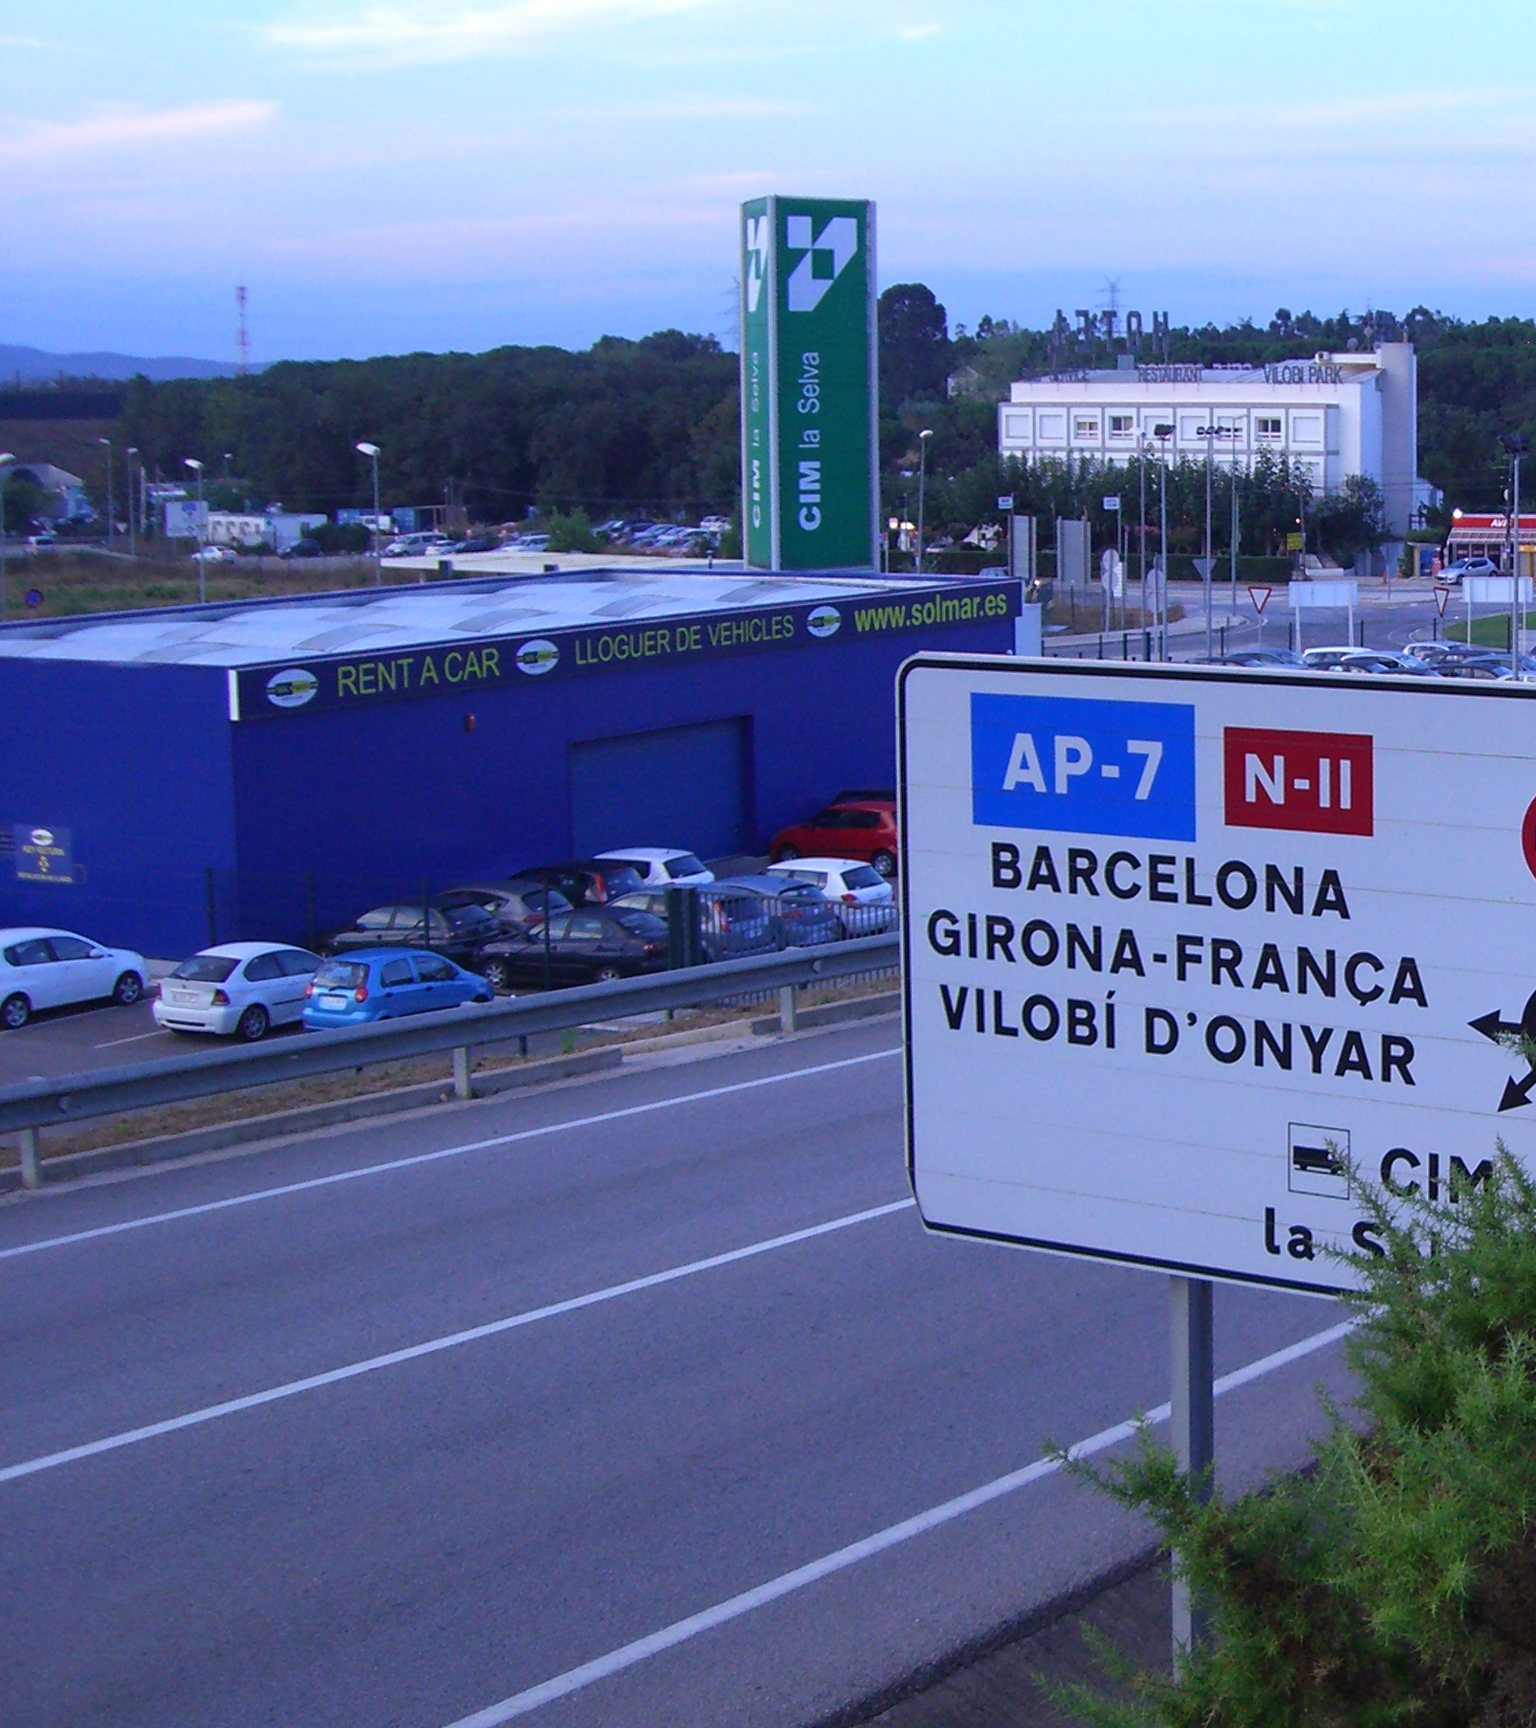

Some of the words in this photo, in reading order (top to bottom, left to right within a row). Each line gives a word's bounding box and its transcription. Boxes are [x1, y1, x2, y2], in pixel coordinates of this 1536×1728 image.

[797, 352, 820, 414] Selva
[1138, 366, 1203, 383] RESTAURANT
[1308, 365, 1344, 384] PARK
[798, 429, 820, 448] la
[798, 460, 821, 531] CIM
[574, 628, 671, 665] LLOGUER
[676, 625, 702, 652] DE
[707, 615, 795, 647] VEHICLES
[854, 592, 1008, 633] www.solmar.es
[337, 658, 414, 697] RENT
[420, 655, 439, 686] A
[444, 648, 500, 683] CAR
[1002, 732, 1164, 801] AP-7
[1244, 752, 1353, 811] N-II
[990, 841, 1351, 920] BARCELONA
[927, 909, 1428, 1008] GIRONA-FRANÇA
[939, 984, 1116, 1049] VILOBÍ
[1145, 1007, 1416, 1086] D'ONYAR
[1380, 1148, 1493, 1205] CIM
[1265, 1207, 1315, 1261] la
